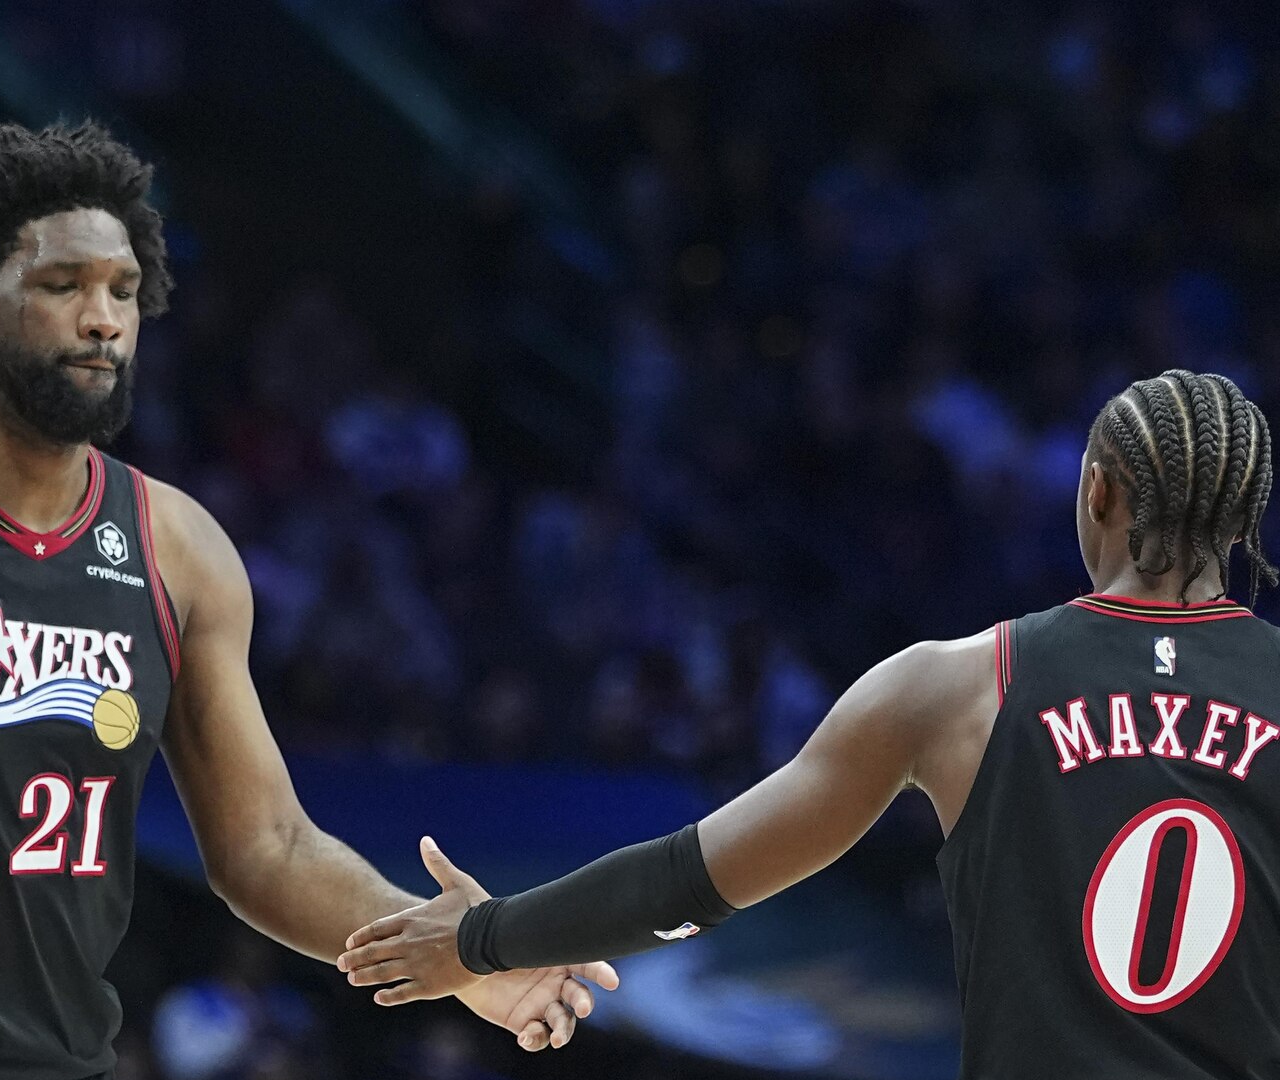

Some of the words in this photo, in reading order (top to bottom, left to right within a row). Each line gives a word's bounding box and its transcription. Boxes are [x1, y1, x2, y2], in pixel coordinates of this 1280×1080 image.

[86, 564, 145, 588] crypto.com
[1155, 665, 1169, 674] NBA
[9, 772, 116, 876] 21
[1082, 797, 1245, 1014] 0
